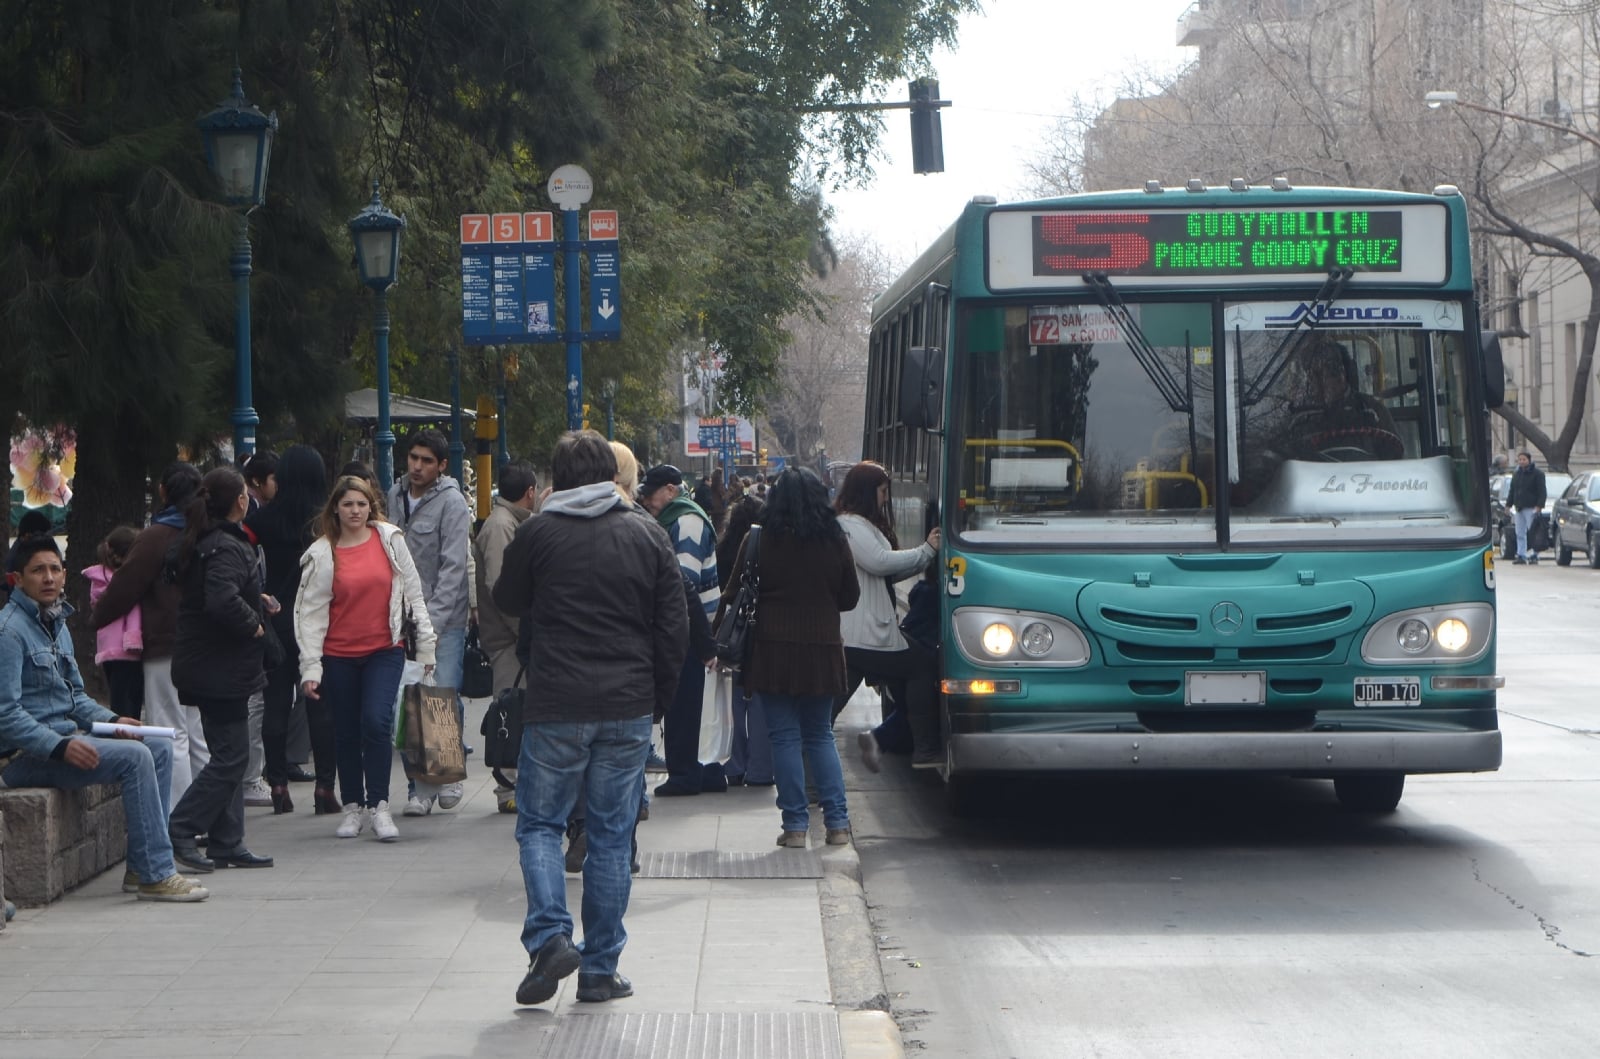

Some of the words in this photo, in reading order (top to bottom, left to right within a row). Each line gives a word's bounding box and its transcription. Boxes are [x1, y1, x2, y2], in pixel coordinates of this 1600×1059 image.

[468, 219, 482, 239] 7
[500, 218, 514, 238] 5
[532, 217, 542, 237] 1
[1186, 211, 1369, 237] GUAYMALLEN
[1041, 212, 1149, 269] 5
[1155, 241, 1243, 268] PARQUE
[1252, 240, 1329, 266] GODOY
[1336, 239, 1398, 265] CRUZ
[1032, 318, 1060, 341] 72
[1061, 313, 1082, 327] SAN
[1080, 328, 1118, 342] COLON
[1318, 474, 1346, 493] La
[1350, 473, 1429, 494] Favorita
[1356, 684, 1383, 701] JDH
[1391, 684, 1418, 700] 170
